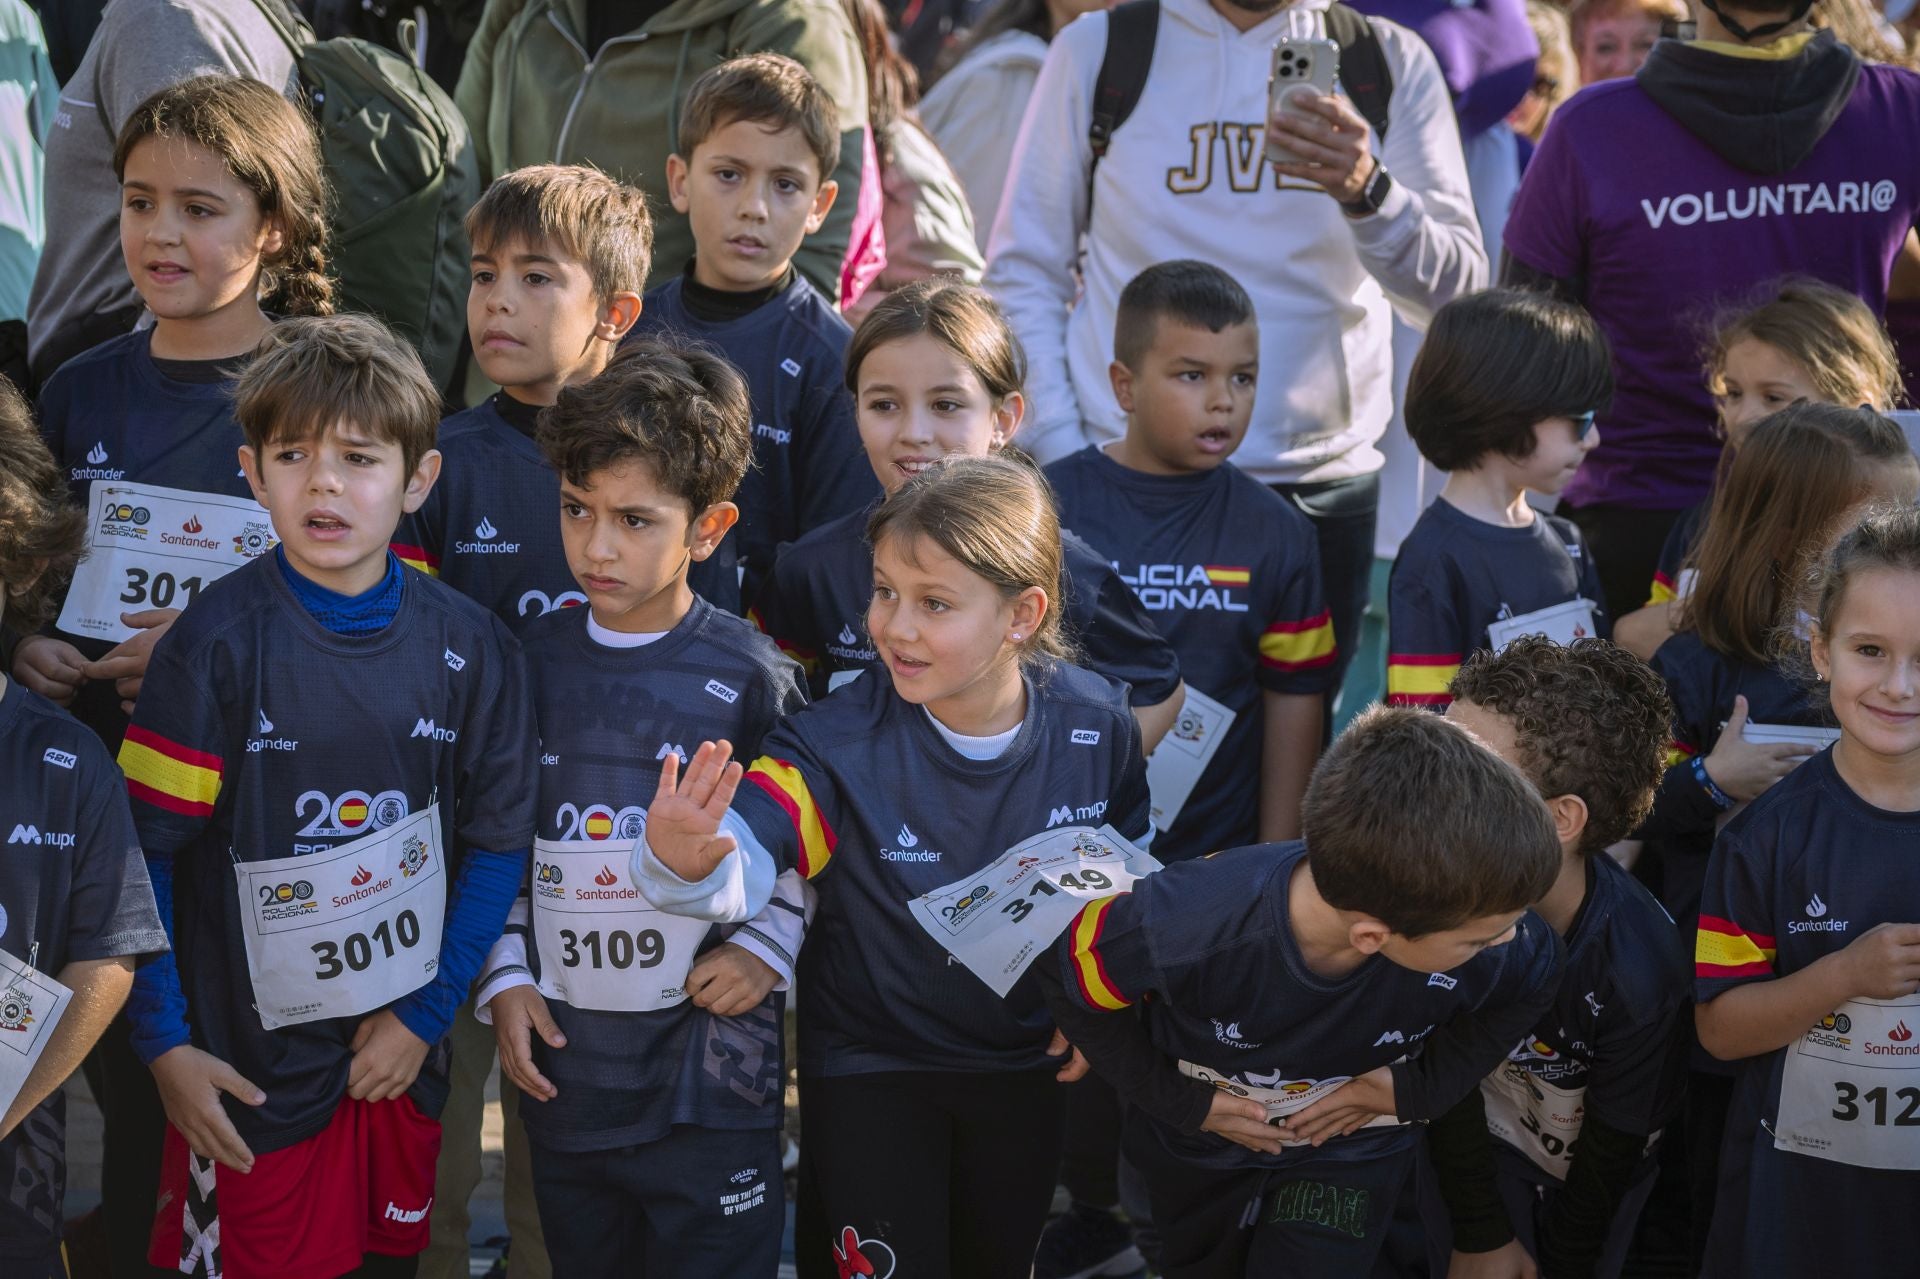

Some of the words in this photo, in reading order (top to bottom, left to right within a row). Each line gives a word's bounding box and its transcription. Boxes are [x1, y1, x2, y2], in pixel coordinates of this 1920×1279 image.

[1167, 121, 1327, 194] JV
[1641, 179, 1897, 229] VOLUNTARI@
[71, 467, 125, 481] Santander
[103, 502, 150, 525] 200
[101, 523, 137, 534] POLICIA
[246, 520, 270, 530] mupol
[100, 529, 147, 541] NACIONAL
[160, 532, 221, 550] Santander
[455, 541, 521, 554] Santander
[119, 567, 212, 609] 301
[708, 683, 738, 702] 42K
[1073, 732, 1098, 743] 42K
[45, 751, 75, 767] 42K
[295, 789, 409, 837] 200
[556, 802, 652, 841] 200
[401, 832, 418, 846] mupol
[879, 848, 942, 862] Santander
[535, 860, 563, 885] 200
[259, 880, 314, 906] 200
[331, 876, 393, 908] Santander
[576, 888, 640, 900] Santander
[1001, 868, 1113, 924] 3149
[262, 903, 305, 915] POLICIA
[263, 908, 319, 921] NACIONAL
[310, 909, 420, 980] 3010
[559, 928, 666, 970] 3109
[9, 984, 33, 1003] mupol
[1814, 1012, 1851, 1035] 00
[1806, 1036, 1850, 1051] NACIONAL
[1808, 1031, 1840, 1043] POLICIA
[720, 1193, 740, 1206] HAVE
[740, 1189, 753, 1201] THE
[752, 1181, 766, 1196] TIME
[724, 1206, 734, 1216] OF
[734, 1199, 752, 1214] YOUR
[752, 1194, 765, 1207] LIFE
